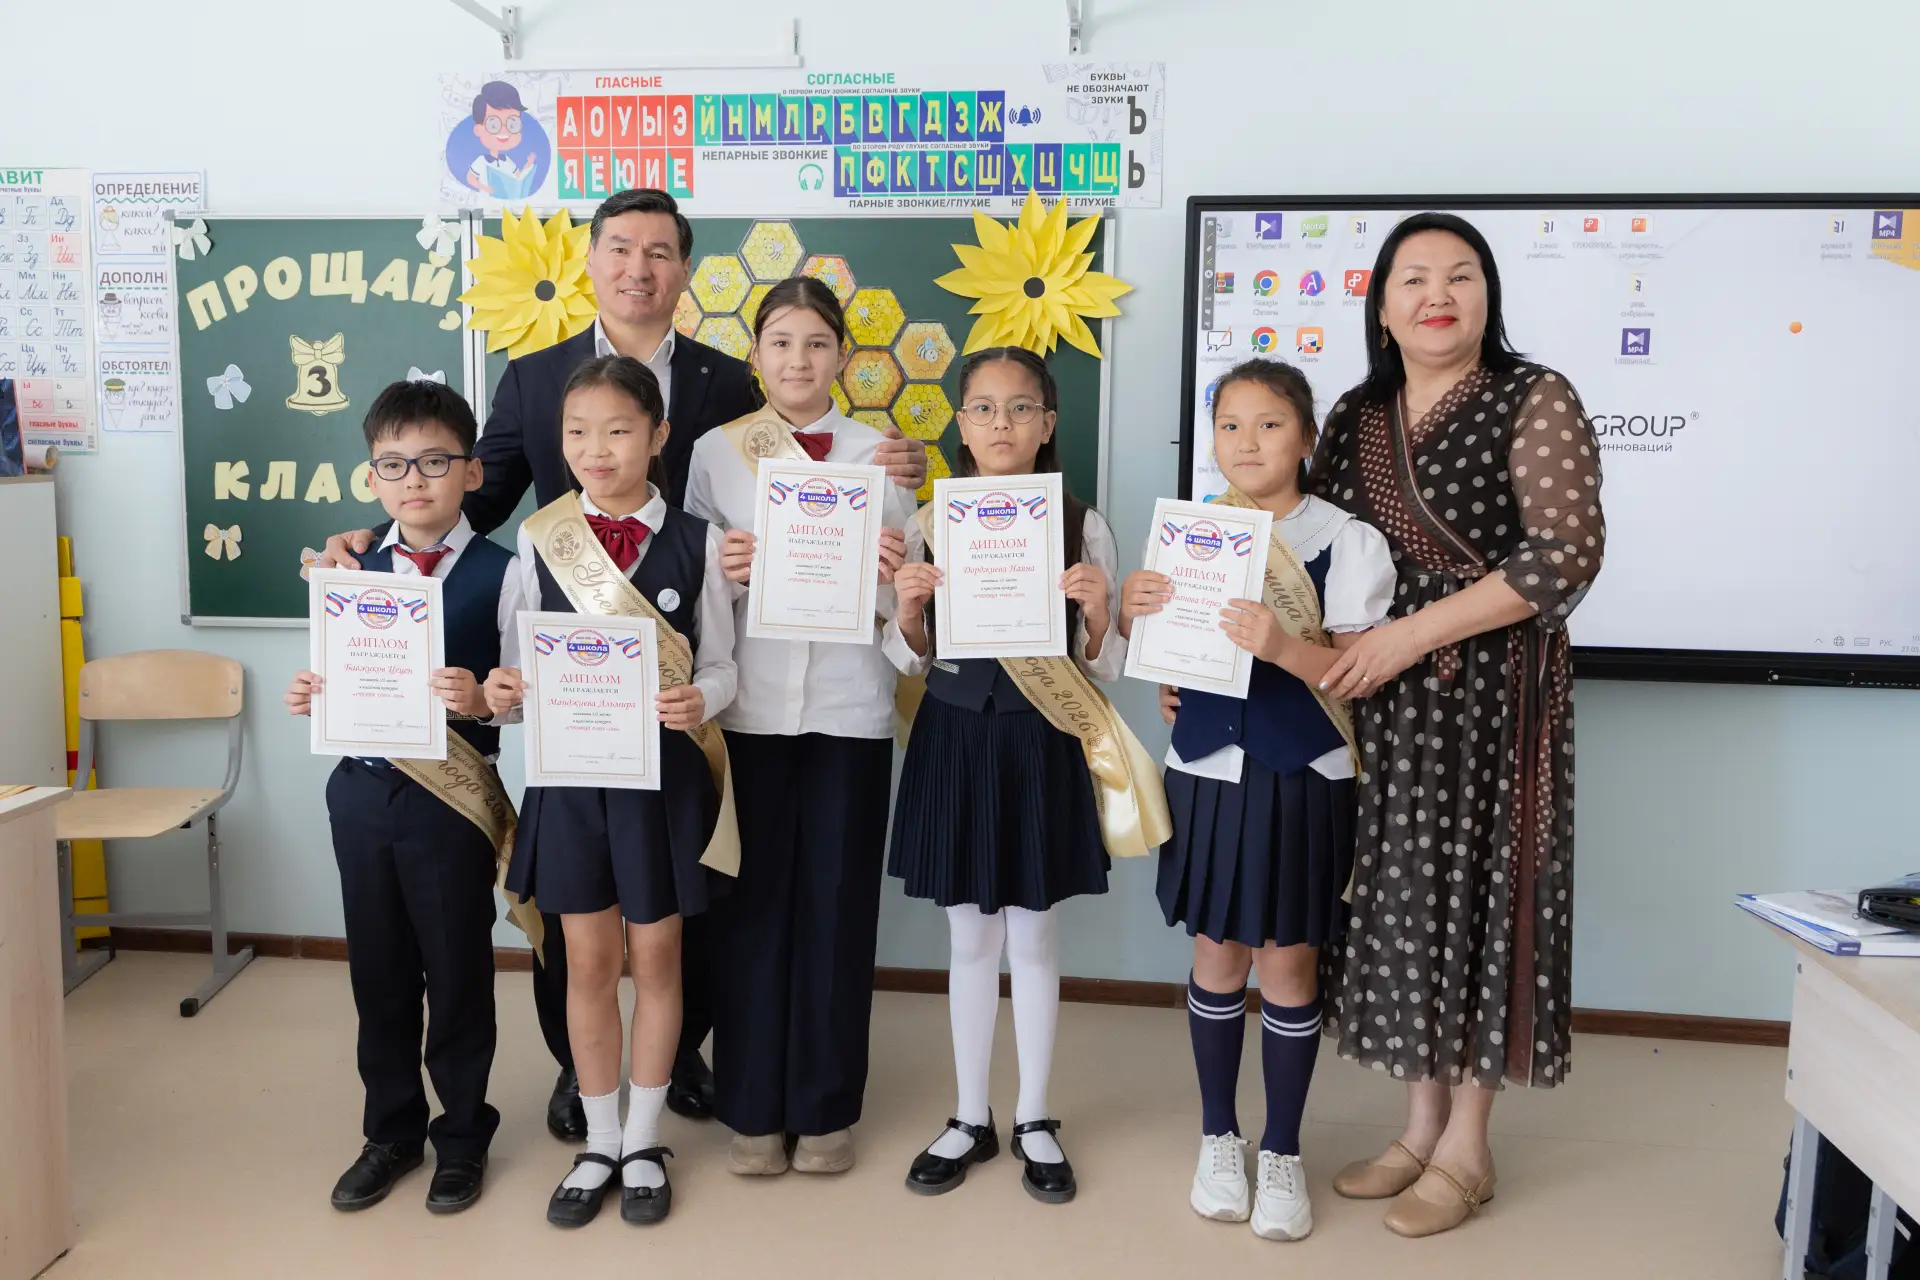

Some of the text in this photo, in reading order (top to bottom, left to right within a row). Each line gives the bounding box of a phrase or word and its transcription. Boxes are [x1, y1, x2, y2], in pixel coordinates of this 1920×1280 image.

[595, 76, 662, 88] ГЛАСНЫЕ
[807, 73, 895, 85] СОГЛАСНЫЕ
[1090, 73, 1126, 81] БУКВЫ
[1082, 84, 1149, 92] ОБОЗНАЧАЮТ
[1091, 96, 1124, 104] ЗВУКИ
[1127, 95, 1147, 135] Ъ
[702, 150, 828, 160] НЕПАРНЫЕ ЗВОНКИЕ
[1128, 150, 1145, 189] Ь
[95, 182, 199, 198] ОПРЕДЕЛЕНИЕ
[849, 198, 991, 208] ПАРНЫЕ ЗВОНКИЕ/ГЛУХИЕ
[1074, 198, 1116, 206] ГЛУХИЕ
[19, 272, 66, 280] Мм Нн
[100, 271, 167, 286] ДОПОЛН
[20, 308, 65, 316] Сс Тт
[102, 360, 171, 372] ОБСТОЯТЕЛ
[307, 366, 331, 397] 3
[1598, 442, 1673, 452] инноваций
[214, 460, 378, 503] КЛАС
[808, 494, 836, 502] школа
[987, 508, 1016, 516] школа
[787, 524, 844, 537] ДИПЛОМ
[788, 538, 841, 546] НАГРАЖДАЕТСЯ
[969, 538, 1028, 551] ДИПЛОМ
[1194, 537, 1220, 547] школа
[1171, 565, 1228, 583] ДИПЛОМ
[1171, 580, 1222, 593] НАГРАЖДАЕТСЯ
[367, 606, 397, 614] школа
[347, 637, 408, 650] ДИПЛОМ
[577, 644, 607, 652] школа
[350, 651, 406, 660] НАГРАЖДАЕТСЯ
[560, 673, 621, 685] ДИПЛОМ
[1051, 689, 1099, 732] 2026
